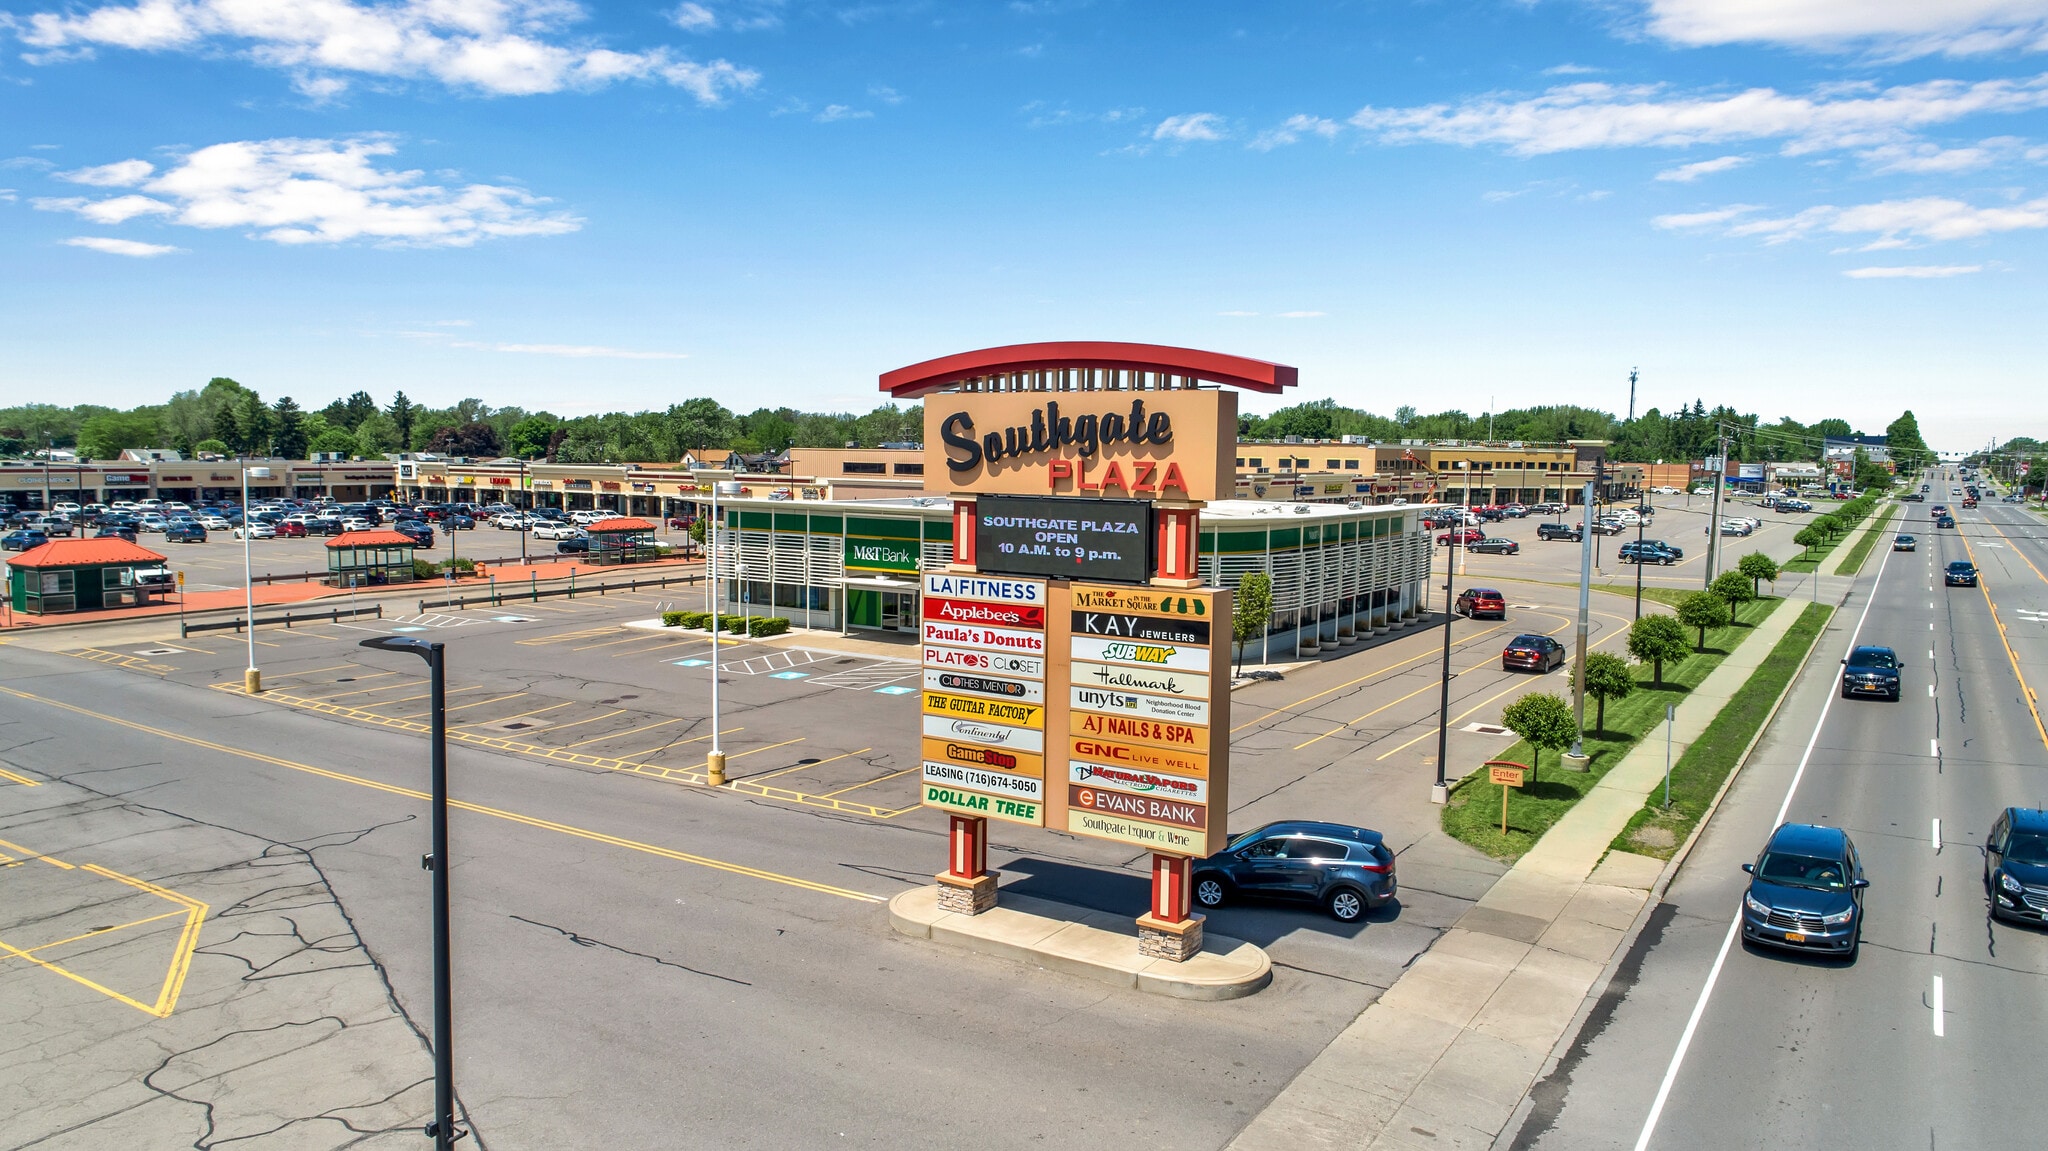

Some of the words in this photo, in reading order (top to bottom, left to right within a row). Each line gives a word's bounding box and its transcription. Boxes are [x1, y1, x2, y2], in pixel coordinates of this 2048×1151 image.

[941, 399, 1172, 471] Southgate
[1049, 459, 1188, 492] PLAZA
[984, 516, 1077, 531] SOUTHGATE
[1081, 520, 1139, 534] PLAZA
[1035, 532, 1078, 544] OPEN
[853, 545, 882, 561] M&T
[882, 547, 910, 563] Bank
[998, 543, 1014, 553] 10
[1018, 544, 1050, 556] A.M.
[1055, 546, 1071, 557] to
[1075, 547, 1084, 558] 9
[1089, 550, 1121, 560] p.m.
[960, 580, 1036, 600] FITNESS
[940, 601, 1020, 622] Applebee's
[1076, 592, 1125, 607] MARKET
[1126, 597, 1158, 610] SQUARE
[926, 626, 980, 643] Paula's
[983, 631, 1042, 649] Donuts
[1085, 613, 1138, 636] KAY
[1139, 630, 1195, 642] JEWELERS
[926, 649, 989, 668] PLATO'S
[993, 657, 1041, 673] CLOSET
[1102, 643, 1177, 664] SUBWAY
[941, 675, 980, 689] CLOTHES
[982, 680, 1021, 694] MENTOR
[1092, 665, 1184, 694] Hallmark
[928, 695, 947, 709] THE
[949, 699, 985, 714] GUITAR
[988, 704, 1037, 724] FACTORY
[1079, 690, 1124, 708] unyts
[1146, 699, 1184, 710] Neighborhood
[1185, 702, 1201, 711] Blood
[1151, 706, 1176, 716] Donation
[1177, 709, 1195, 718] Center
[951, 720, 1012, 741] Continental
[1082, 715, 1104, 735] AJ
[1108, 719, 1149, 738] NAILS
[1152, 723, 1162, 740] &
[1166, 725, 1194, 744] SPA
[947, 744, 1016, 769] GameStop
[1075, 741, 1130, 760] GNC
[1132, 754, 1159, 764] LIVE
[1165, 759, 1200, 770] WELL
[925, 765, 963, 780] LEASING
[965, 771, 1037, 793] (716)674-5050
[1492, 769, 1520, 779] Enter
[1114, 780, 1152, 789] ELECTRONI
[1155, 786, 1198, 797] CIGARETTES
[927, 788, 989, 810] DOLLAR
[996, 800, 1036, 819] TREE
[1096, 793, 1146, 814] EVANS
[1150, 802, 1196, 823] BANK
[1083, 817, 1126, 835] Southgate
[1158, 831, 1165, 842] &
[1167, 831, 1190, 846] Wine
